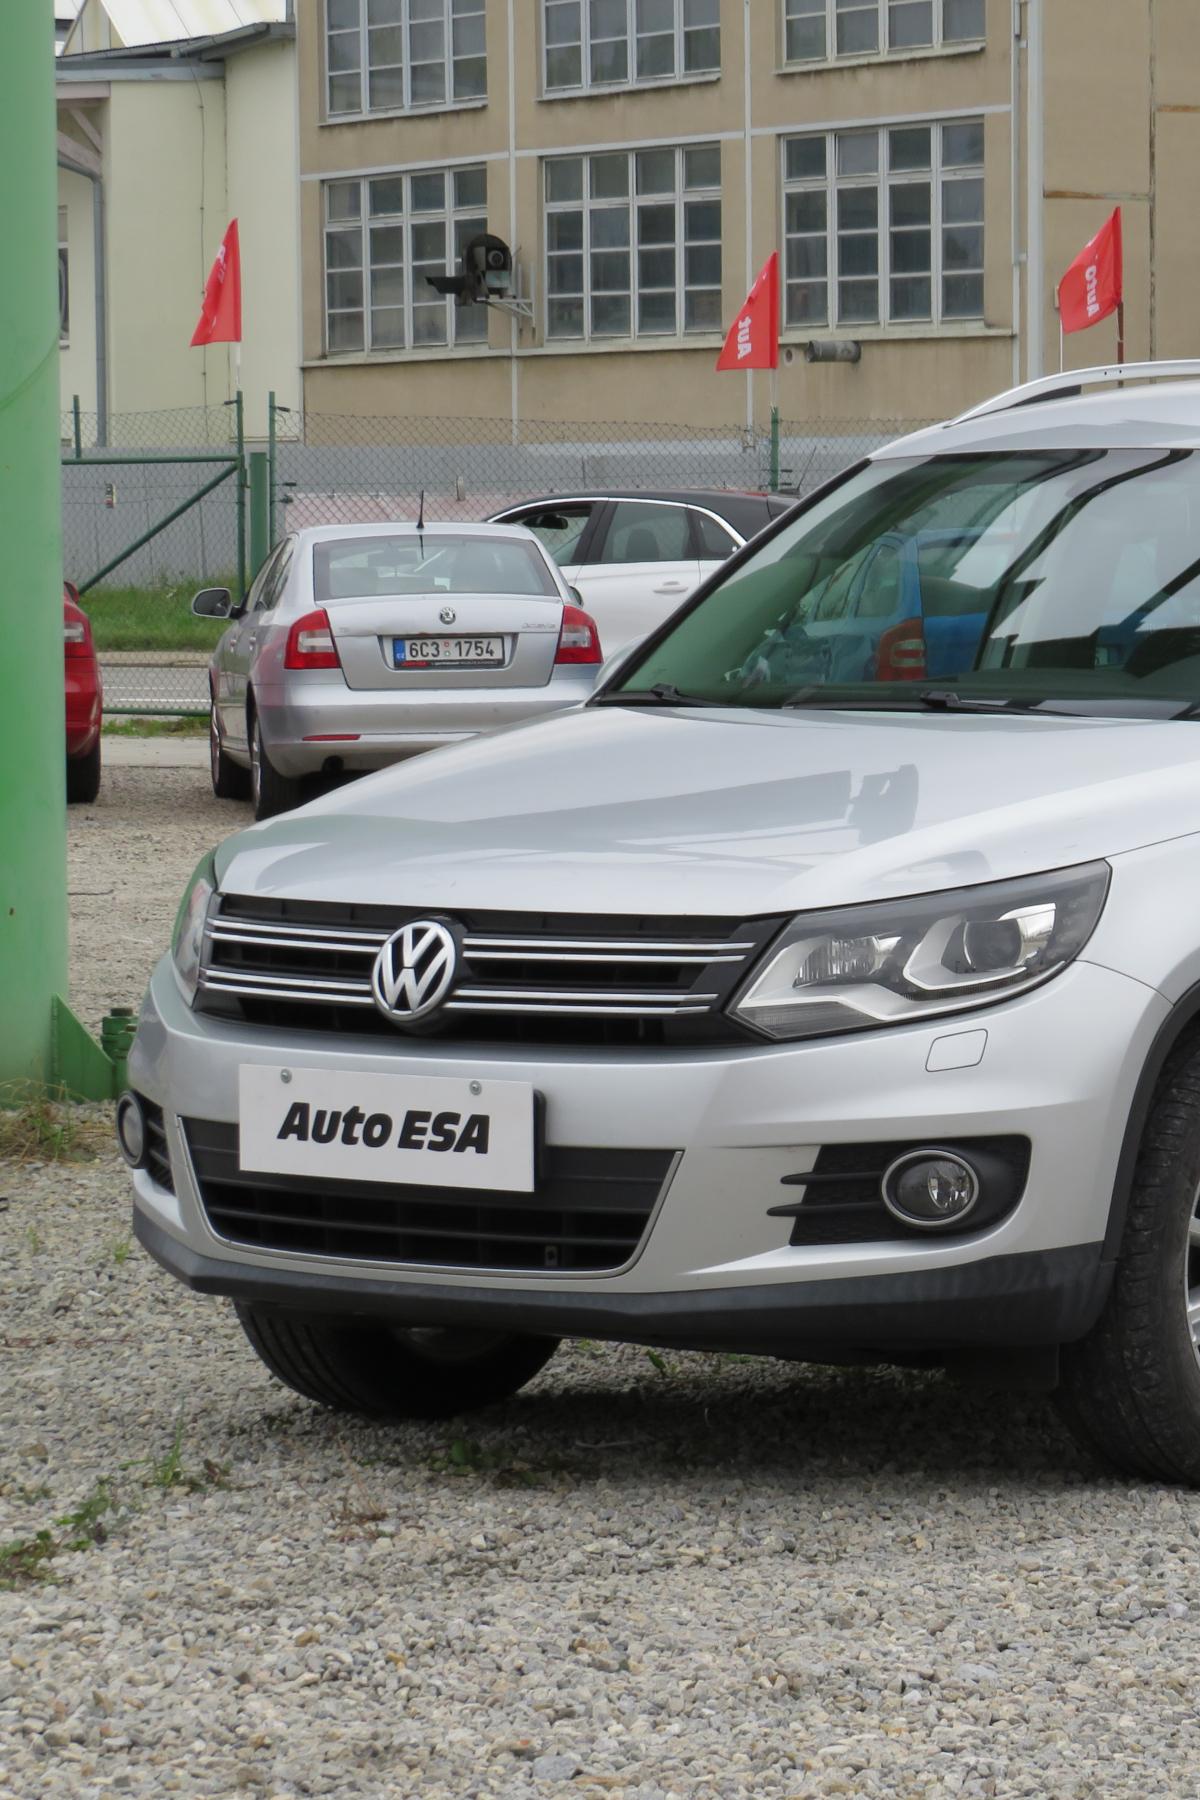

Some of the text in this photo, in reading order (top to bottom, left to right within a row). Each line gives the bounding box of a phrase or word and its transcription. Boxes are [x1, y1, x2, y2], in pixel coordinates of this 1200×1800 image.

[409, 640, 495, 659] 6C3 1754
[276, 1101, 491, 1155] Auto ESA
